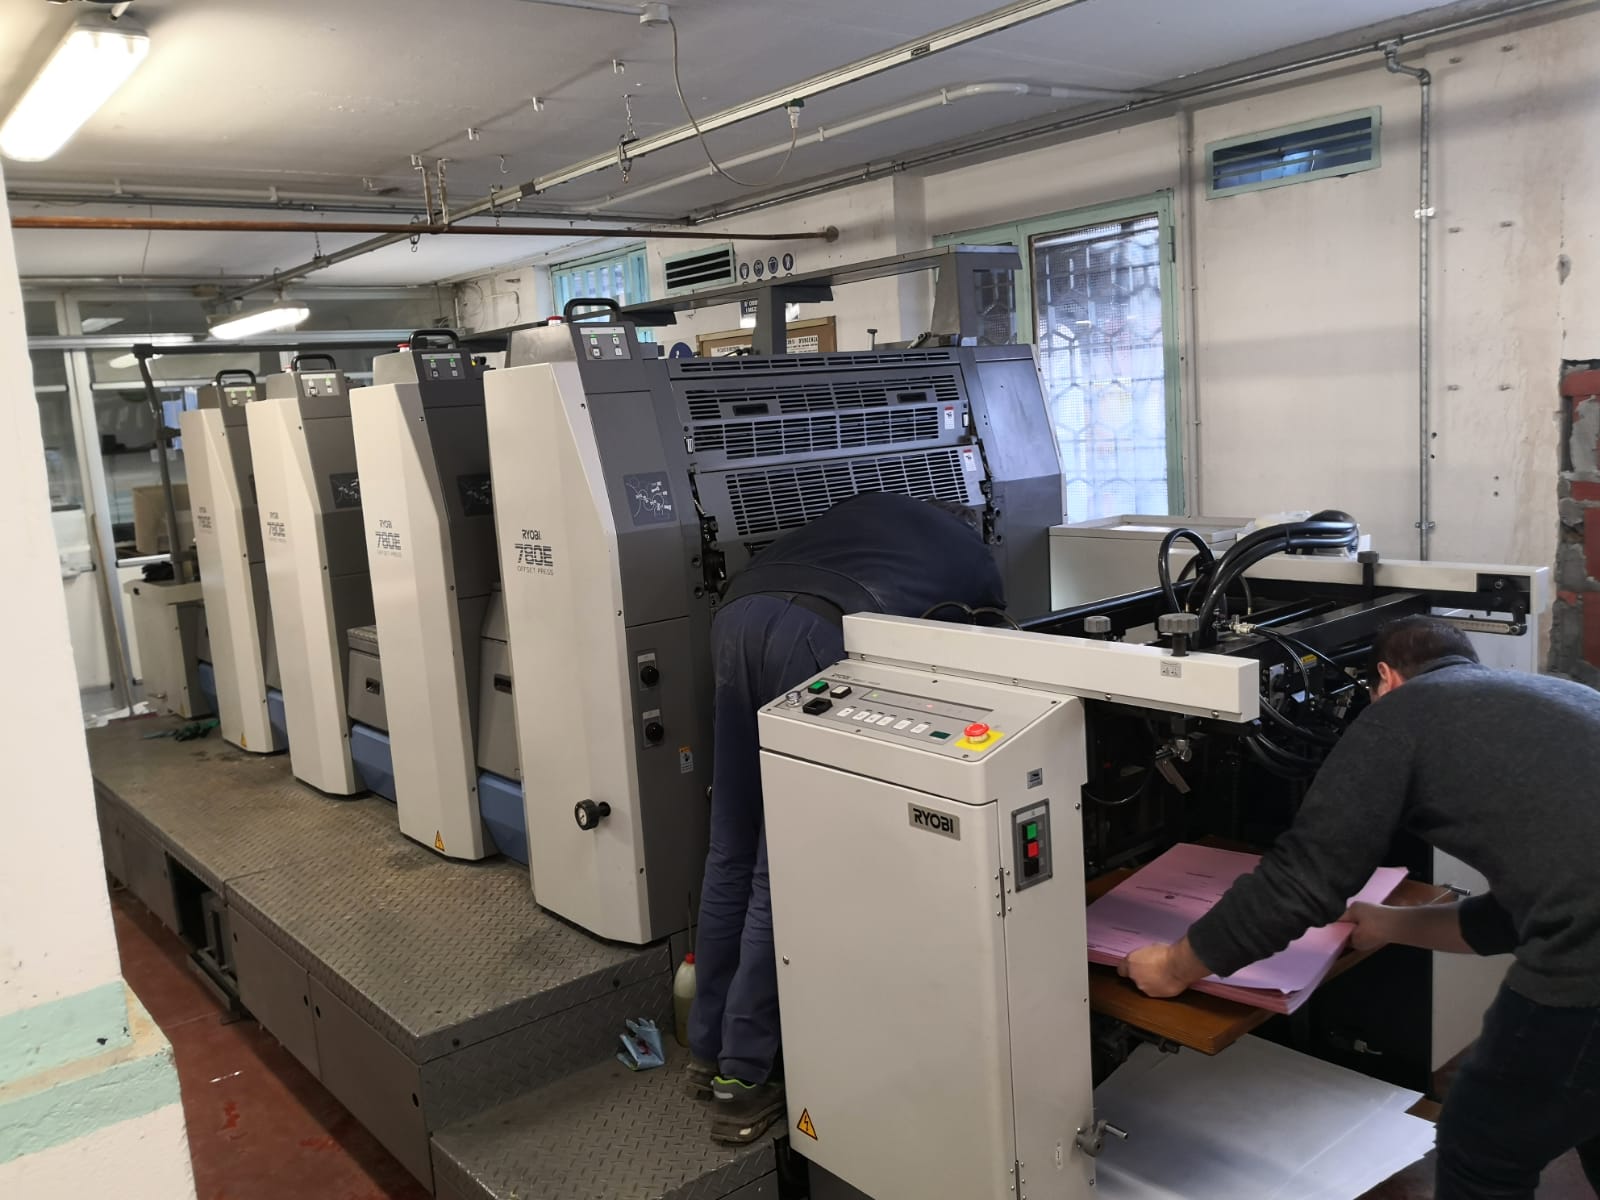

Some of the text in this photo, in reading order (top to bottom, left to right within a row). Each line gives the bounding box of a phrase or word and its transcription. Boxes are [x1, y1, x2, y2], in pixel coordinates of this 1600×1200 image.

[375, 531, 401, 550] 780E
[521, 529, 541, 540] RYOBI
[514, 543, 553, 567] 780E
[912, 807, 954, 834] RYOBI
